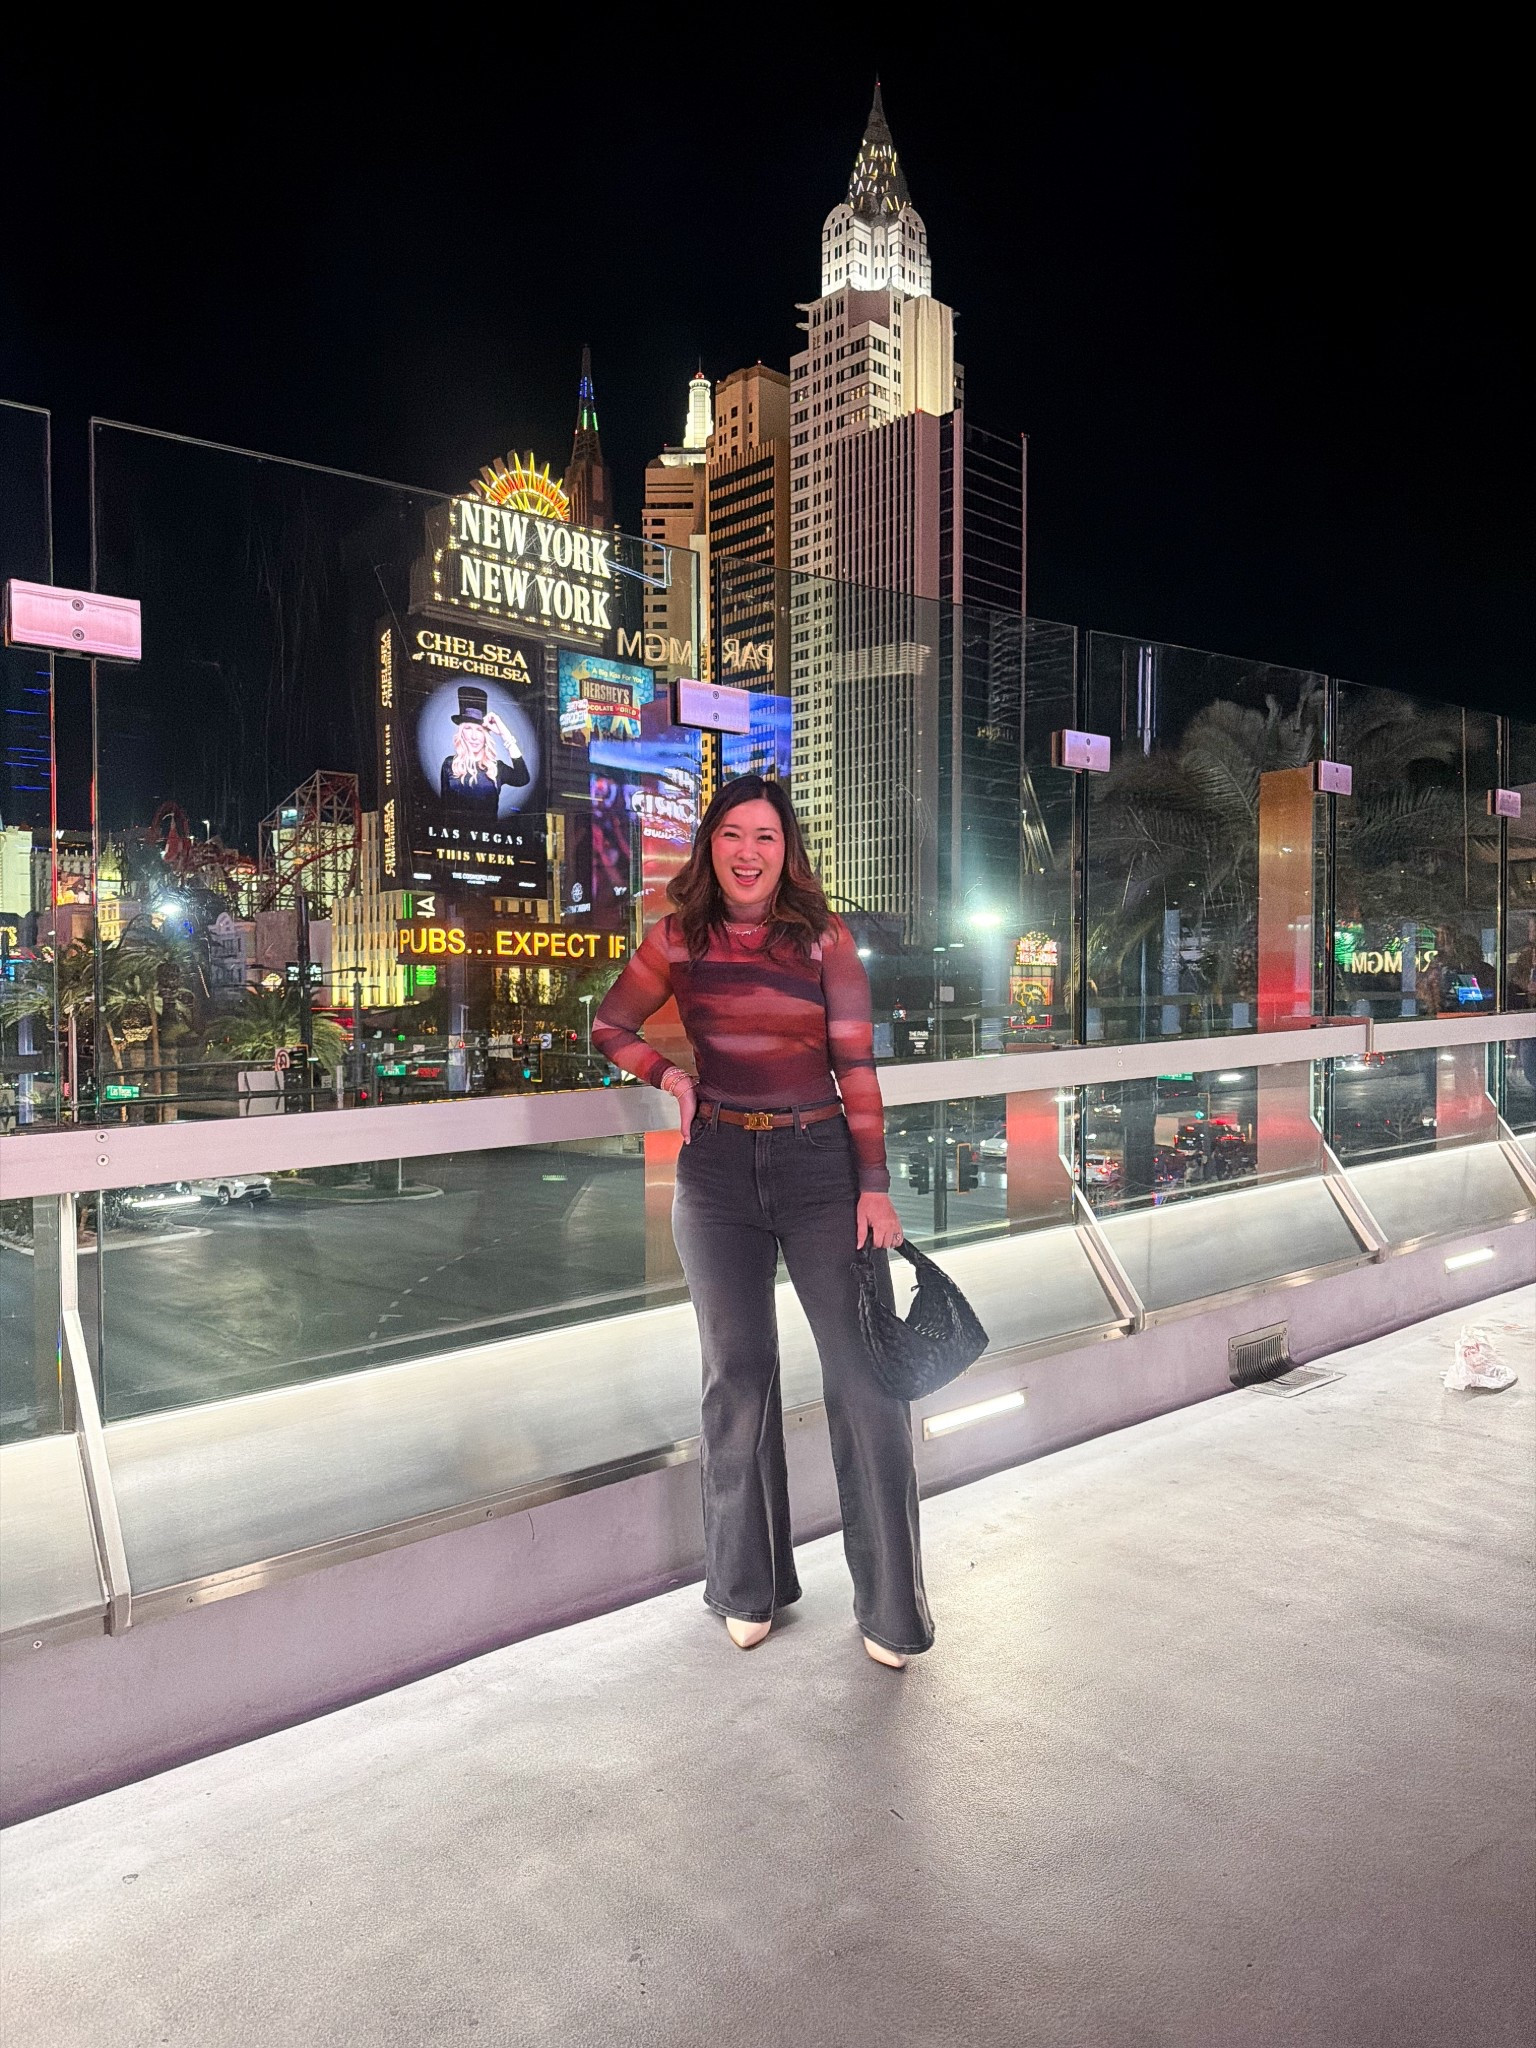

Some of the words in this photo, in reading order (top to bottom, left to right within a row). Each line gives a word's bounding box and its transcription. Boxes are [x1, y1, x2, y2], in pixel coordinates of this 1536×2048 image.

[460, 500, 529, 556] NEW
[535, 521, 611, 579] YORK
[460, 554, 530, 609] NEW
[535, 575, 612, 630] YORK
[417, 630, 528, 669] CHELSEA
[582, 681, 629, 705] HERSHEY'S
[428, 826, 460, 839] LAS
[470, 830, 523, 845] VEGAS
[436, 848, 470, 861] THIS
[475, 852, 515, 866] WEEK
